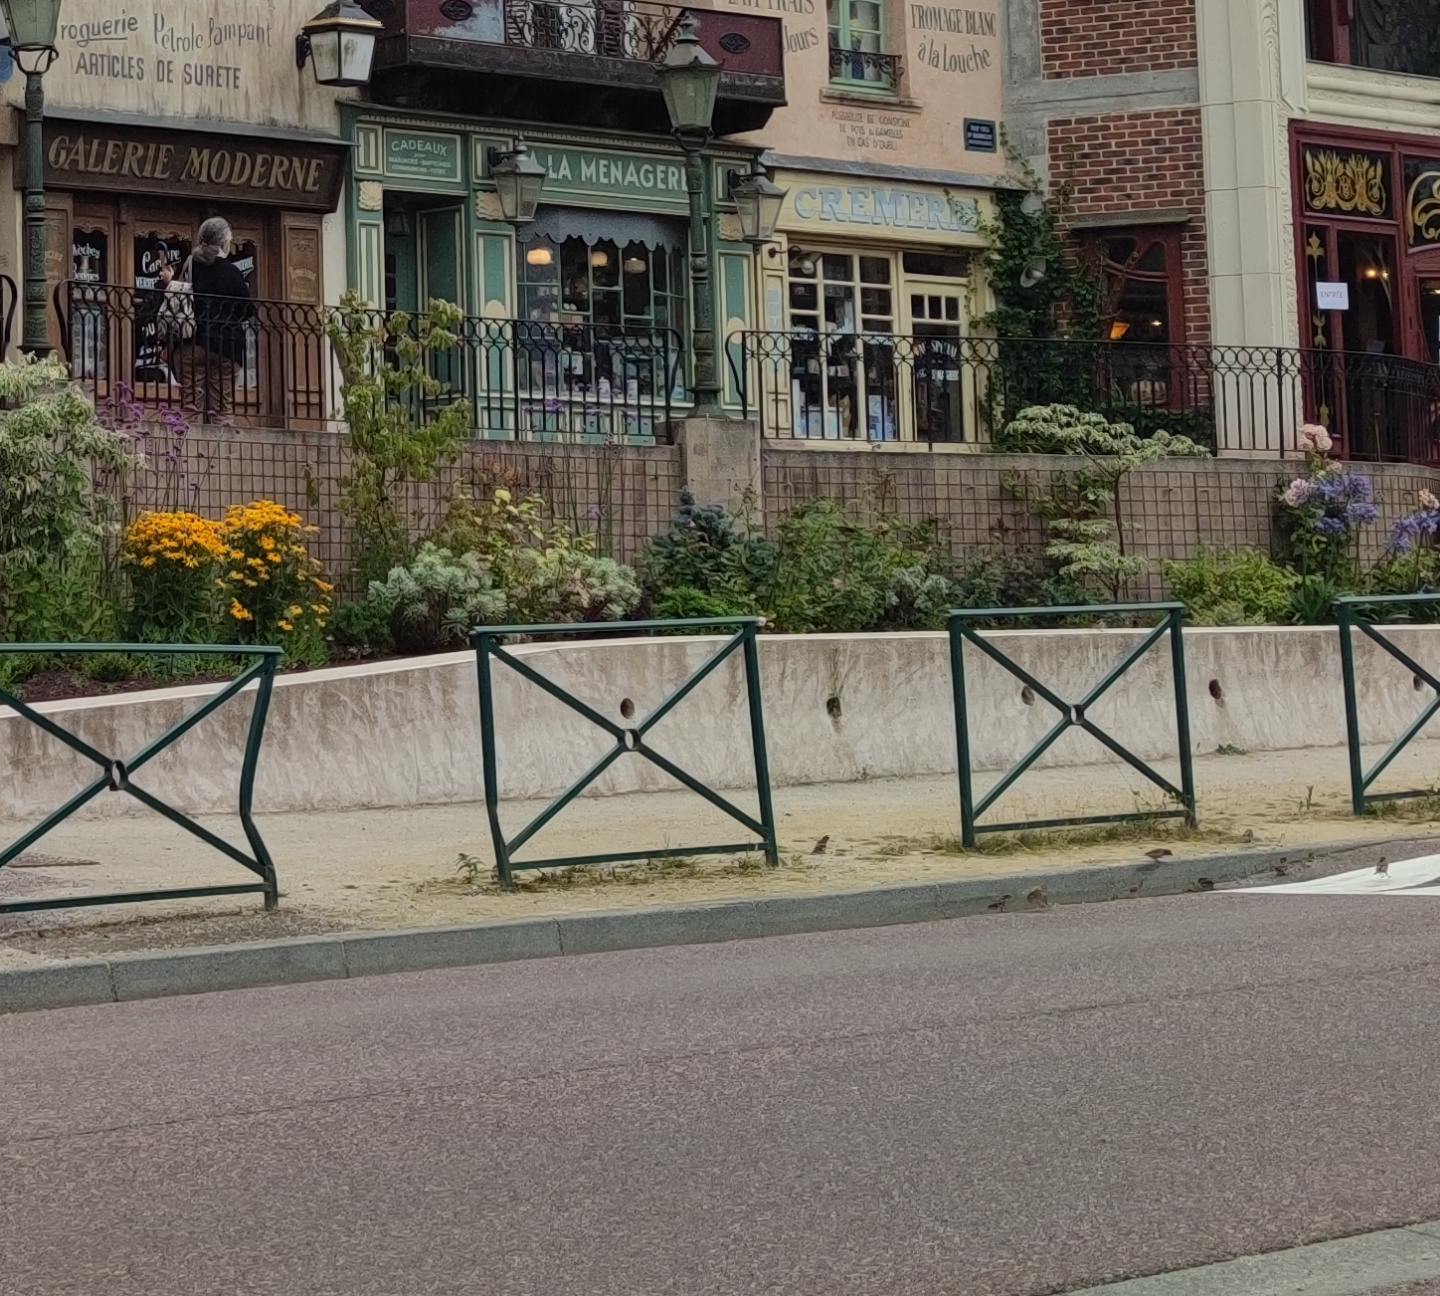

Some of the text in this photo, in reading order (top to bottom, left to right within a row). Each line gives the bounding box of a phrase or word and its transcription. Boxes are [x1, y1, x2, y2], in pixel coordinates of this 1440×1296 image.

[60, 9, 139, 48] roguerie
[910, 3, 997, 38] FROMAGE BLANC
[927, 37, 940, 69] la
[75, 52, 241, 90] ARTICLES DE SURETE
[48, 135, 324, 192] GALERIE MODERNE
[391, 139, 448, 156] CADEAUX
[547, 153, 573, 181] LA
